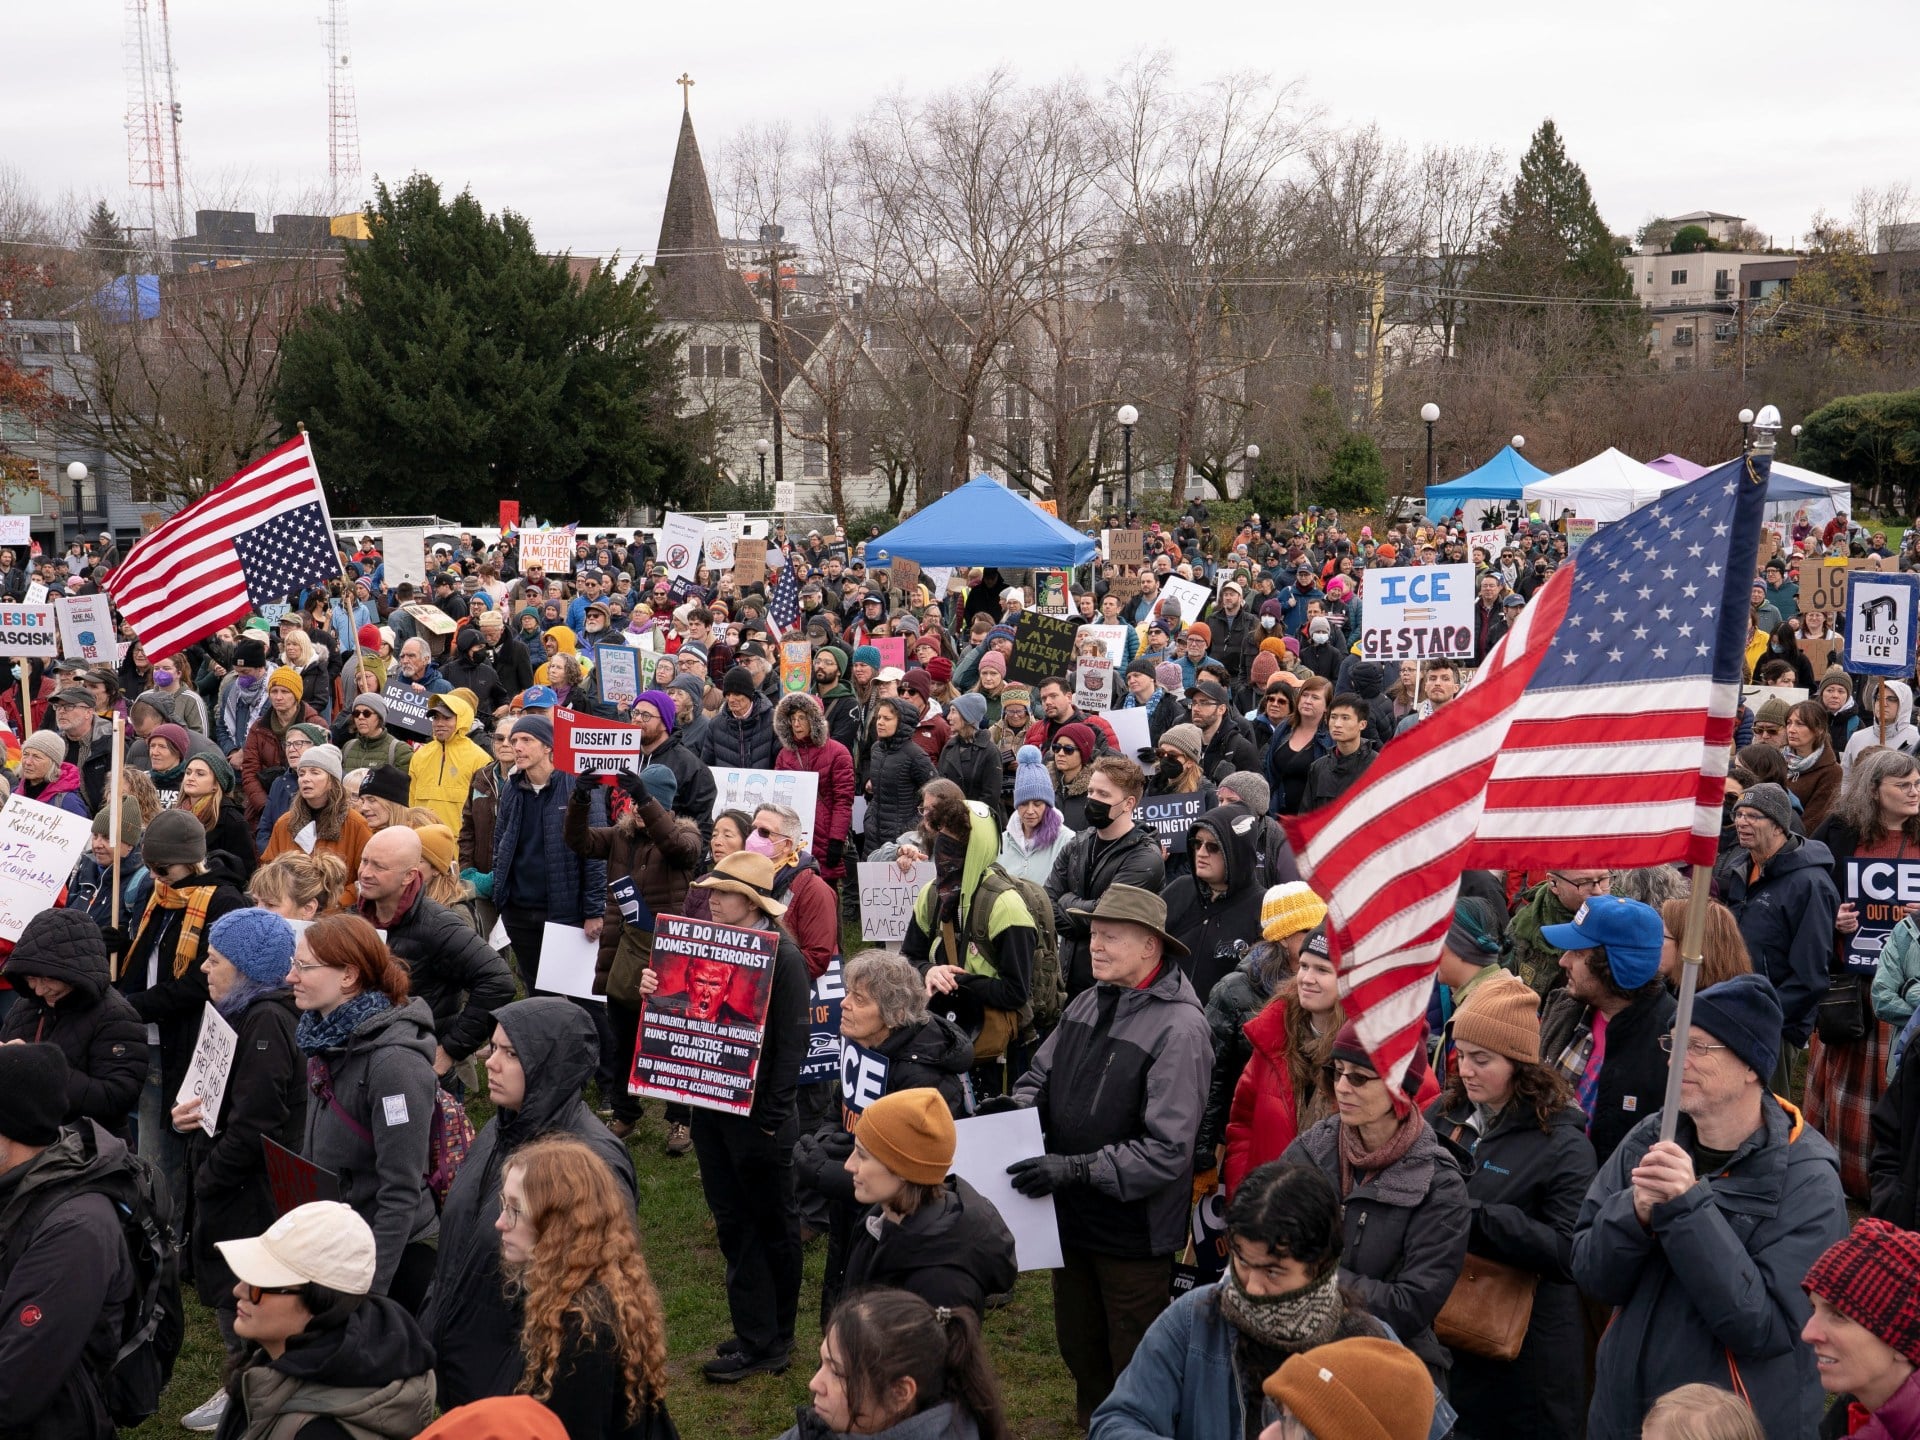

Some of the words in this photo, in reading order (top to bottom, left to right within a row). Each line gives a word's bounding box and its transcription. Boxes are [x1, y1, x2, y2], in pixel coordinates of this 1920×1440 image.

[523, 534, 544, 545] THEY
[547, 535, 569, 546] SHOT
[1114, 533, 1137, 543] ANTI
[1470, 532, 1499, 544] FUCK
[523, 546, 530, 557] A
[532, 546, 569, 558] MOTHER
[1111, 550, 1142, 561] FASCIST
[547, 559, 569, 572] FACE
[1817, 567, 1861, 588] IC
[1172, 585, 1200, 606] ICE
[1381, 572, 1451, 605] ICE
[0, 612, 47, 627] ESIST
[1037, 606, 1068, 614] RESIST
[1019, 611, 1030, 624] I
[1037, 614, 1073, 636] TAKE
[0, 632, 54, 646] ASCISM
[1026, 630, 1054, 646] MY
[1363, 626, 1471, 654] GESTAPO
[1859, 634, 1899, 646] DEFUND
[606, 651, 626, 660] MELT
[1015, 640, 1071, 664] WHISKY
[1867, 645, 1891, 658] ICE
[610, 665, 626, 674] ICE
[1016, 655, 1060, 677] NEAT
[386, 685, 403, 699] ICE
[607, 692, 634, 702] GOOD
[1077, 700, 1107, 709] FASCISM
[559, 710, 574, 721] ACLU
[575, 732, 617, 746] DISSENT
[621, 733, 632, 745] IS
[580, 756, 631, 770] PATRIOTIC
[725, 773, 796, 807] ICE
[1131, 807, 1144, 820] CE
[1146, 802, 1182, 819] OUT
[1185, 800, 1200, 815] OF
[7, 843, 37, 863] Ice
[888, 864, 917, 883] NO
[1847, 862, 1920, 901] ICE
[862, 884, 920, 907] GESTAP
[891, 906, 906, 917] IN
[1866, 904, 1890, 921] OUT
[668, 920, 690, 938] WE
[693, 924, 713, 941] DO
[714, 928, 749, 948] HAVE
[750, 936, 761, 951] A
[864, 918, 906, 937] AMER
[655, 936, 709, 958] DOMESTIC
[710, 945, 770, 969] TERRORIST
[1848, 954, 1879, 966] SEA
[815, 1005, 830, 1024] OF
[207, 1014, 216, 1039] WE
[217, 1031, 231, 1058] HAD
[644, 1012, 658, 1023] WHO
[659, 1014, 686, 1030] VIOLENTLY,
[687, 1020, 718, 1036] WILLFULLY,
[717, 1026, 728, 1036] AND
[728, 1026, 763, 1043] VICIOUSLY
[644, 1027, 668, 1041] RUNS
[668, 1031, 690, 1045] OVER
[690, 1036, 723, 1052] JUSTICE
[723, 1044, 732, 1053] IN
[733, 1046, 749, 1057] THIS
[201, 1034, 228, 1078] WHISTLES
[670, 1044, 722, 1066] COUNTRY.
[195, 1049, 211, 1078] THEY
[208, 1071, 220, 1097] HAD
[638, 1057, 653, 1070] END
[653, 1060, 700, 1079] IMMIGRATION
[701, 1069, 751, 1090] ENFORCEMENT
[649, 1074, 656, 1083] &
[656, 1075, 676, 1087] HOLD
[676, 1079, 688, 1089] ICE
[688, 1081, 735, 1100] ACCOUNTABLE
